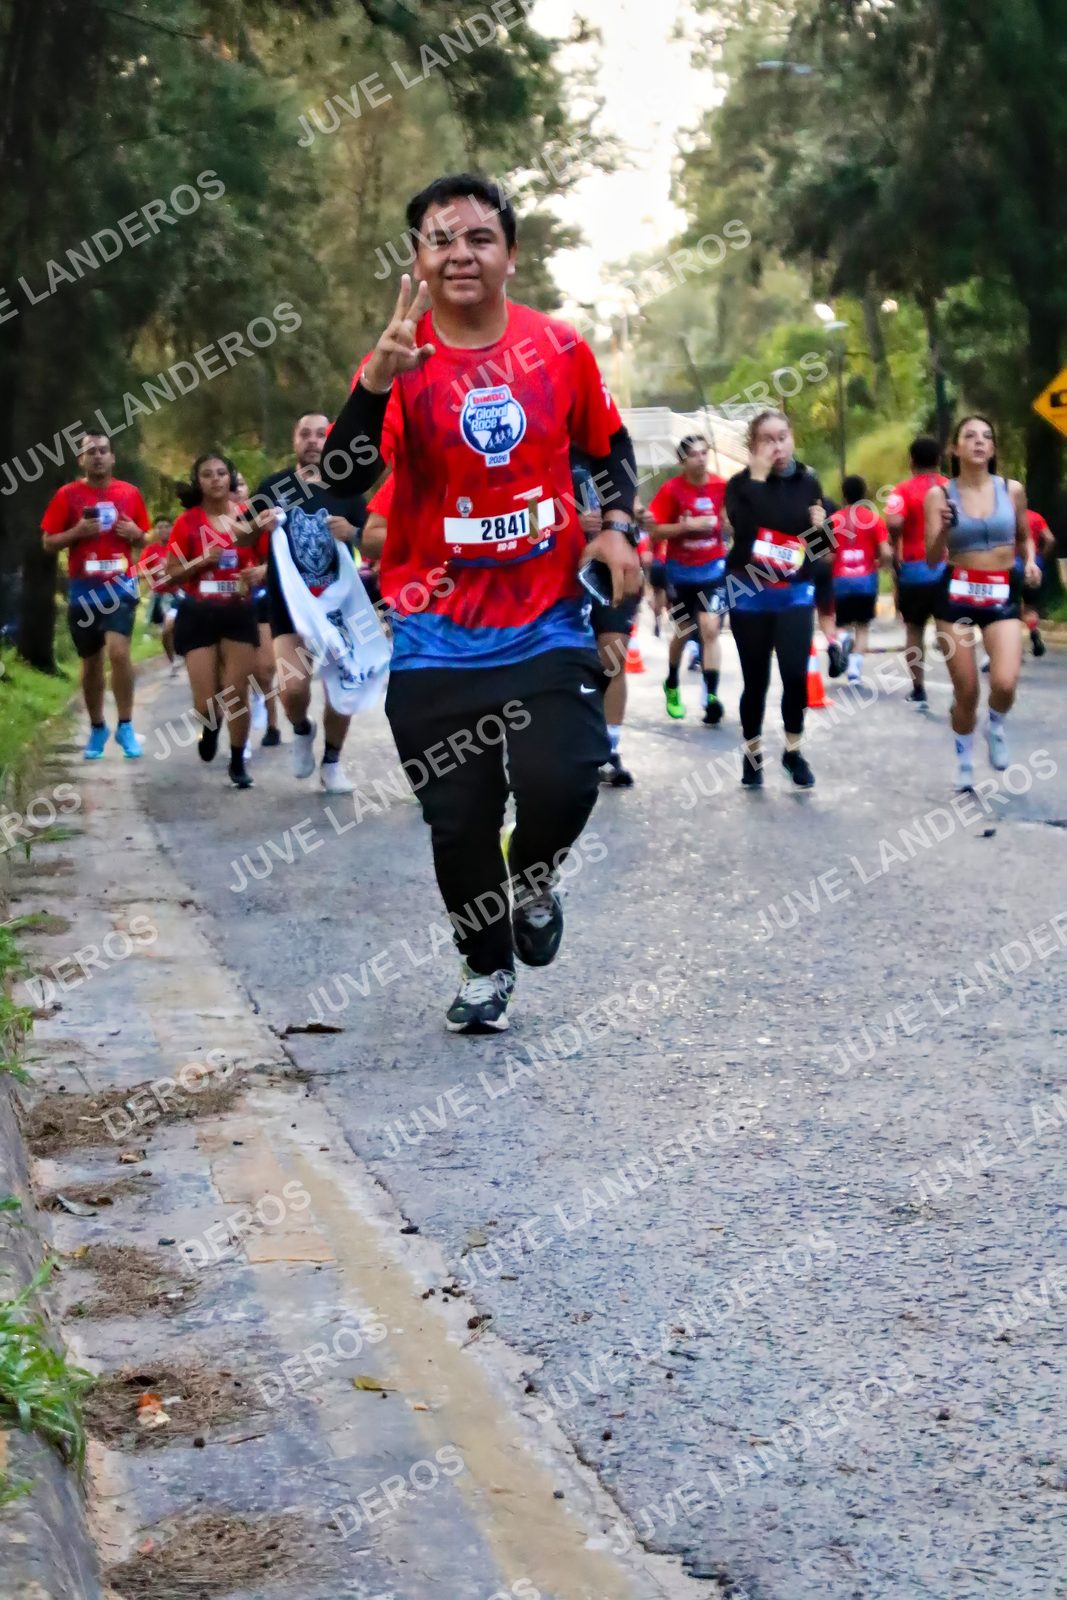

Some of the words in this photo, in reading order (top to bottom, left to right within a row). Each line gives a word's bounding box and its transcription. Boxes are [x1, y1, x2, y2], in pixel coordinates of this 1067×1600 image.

[475, 404, 508, 420] Global
[471, 418, 498, 432] Race
[488, 455, 507, 465] 2026
[481, 511, 526, 540] 2841
